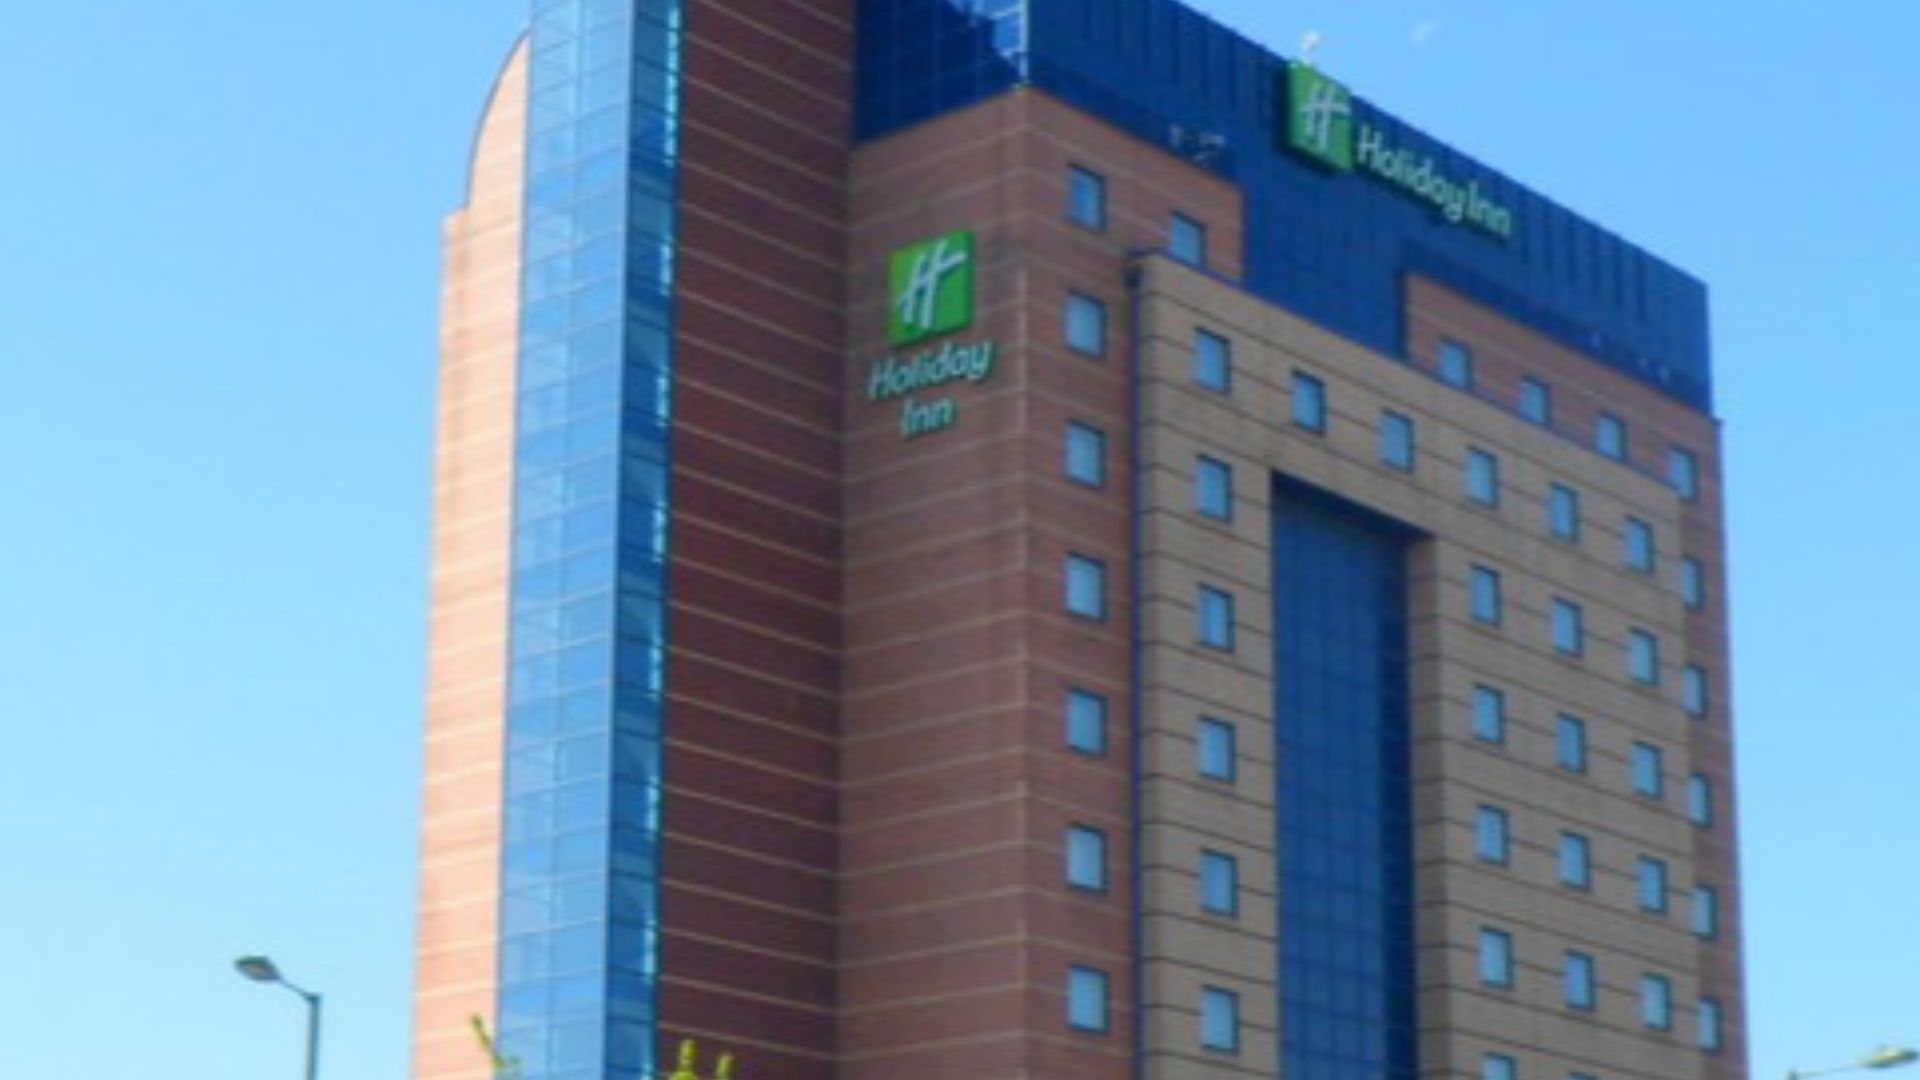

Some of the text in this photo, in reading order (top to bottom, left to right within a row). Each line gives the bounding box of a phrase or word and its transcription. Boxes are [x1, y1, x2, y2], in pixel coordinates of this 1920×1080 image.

[1358, 123, 1511, 237] Holiday Inn
[867, 341, 993, 400] Holiday
[902, 398, 955, 437] Inn
